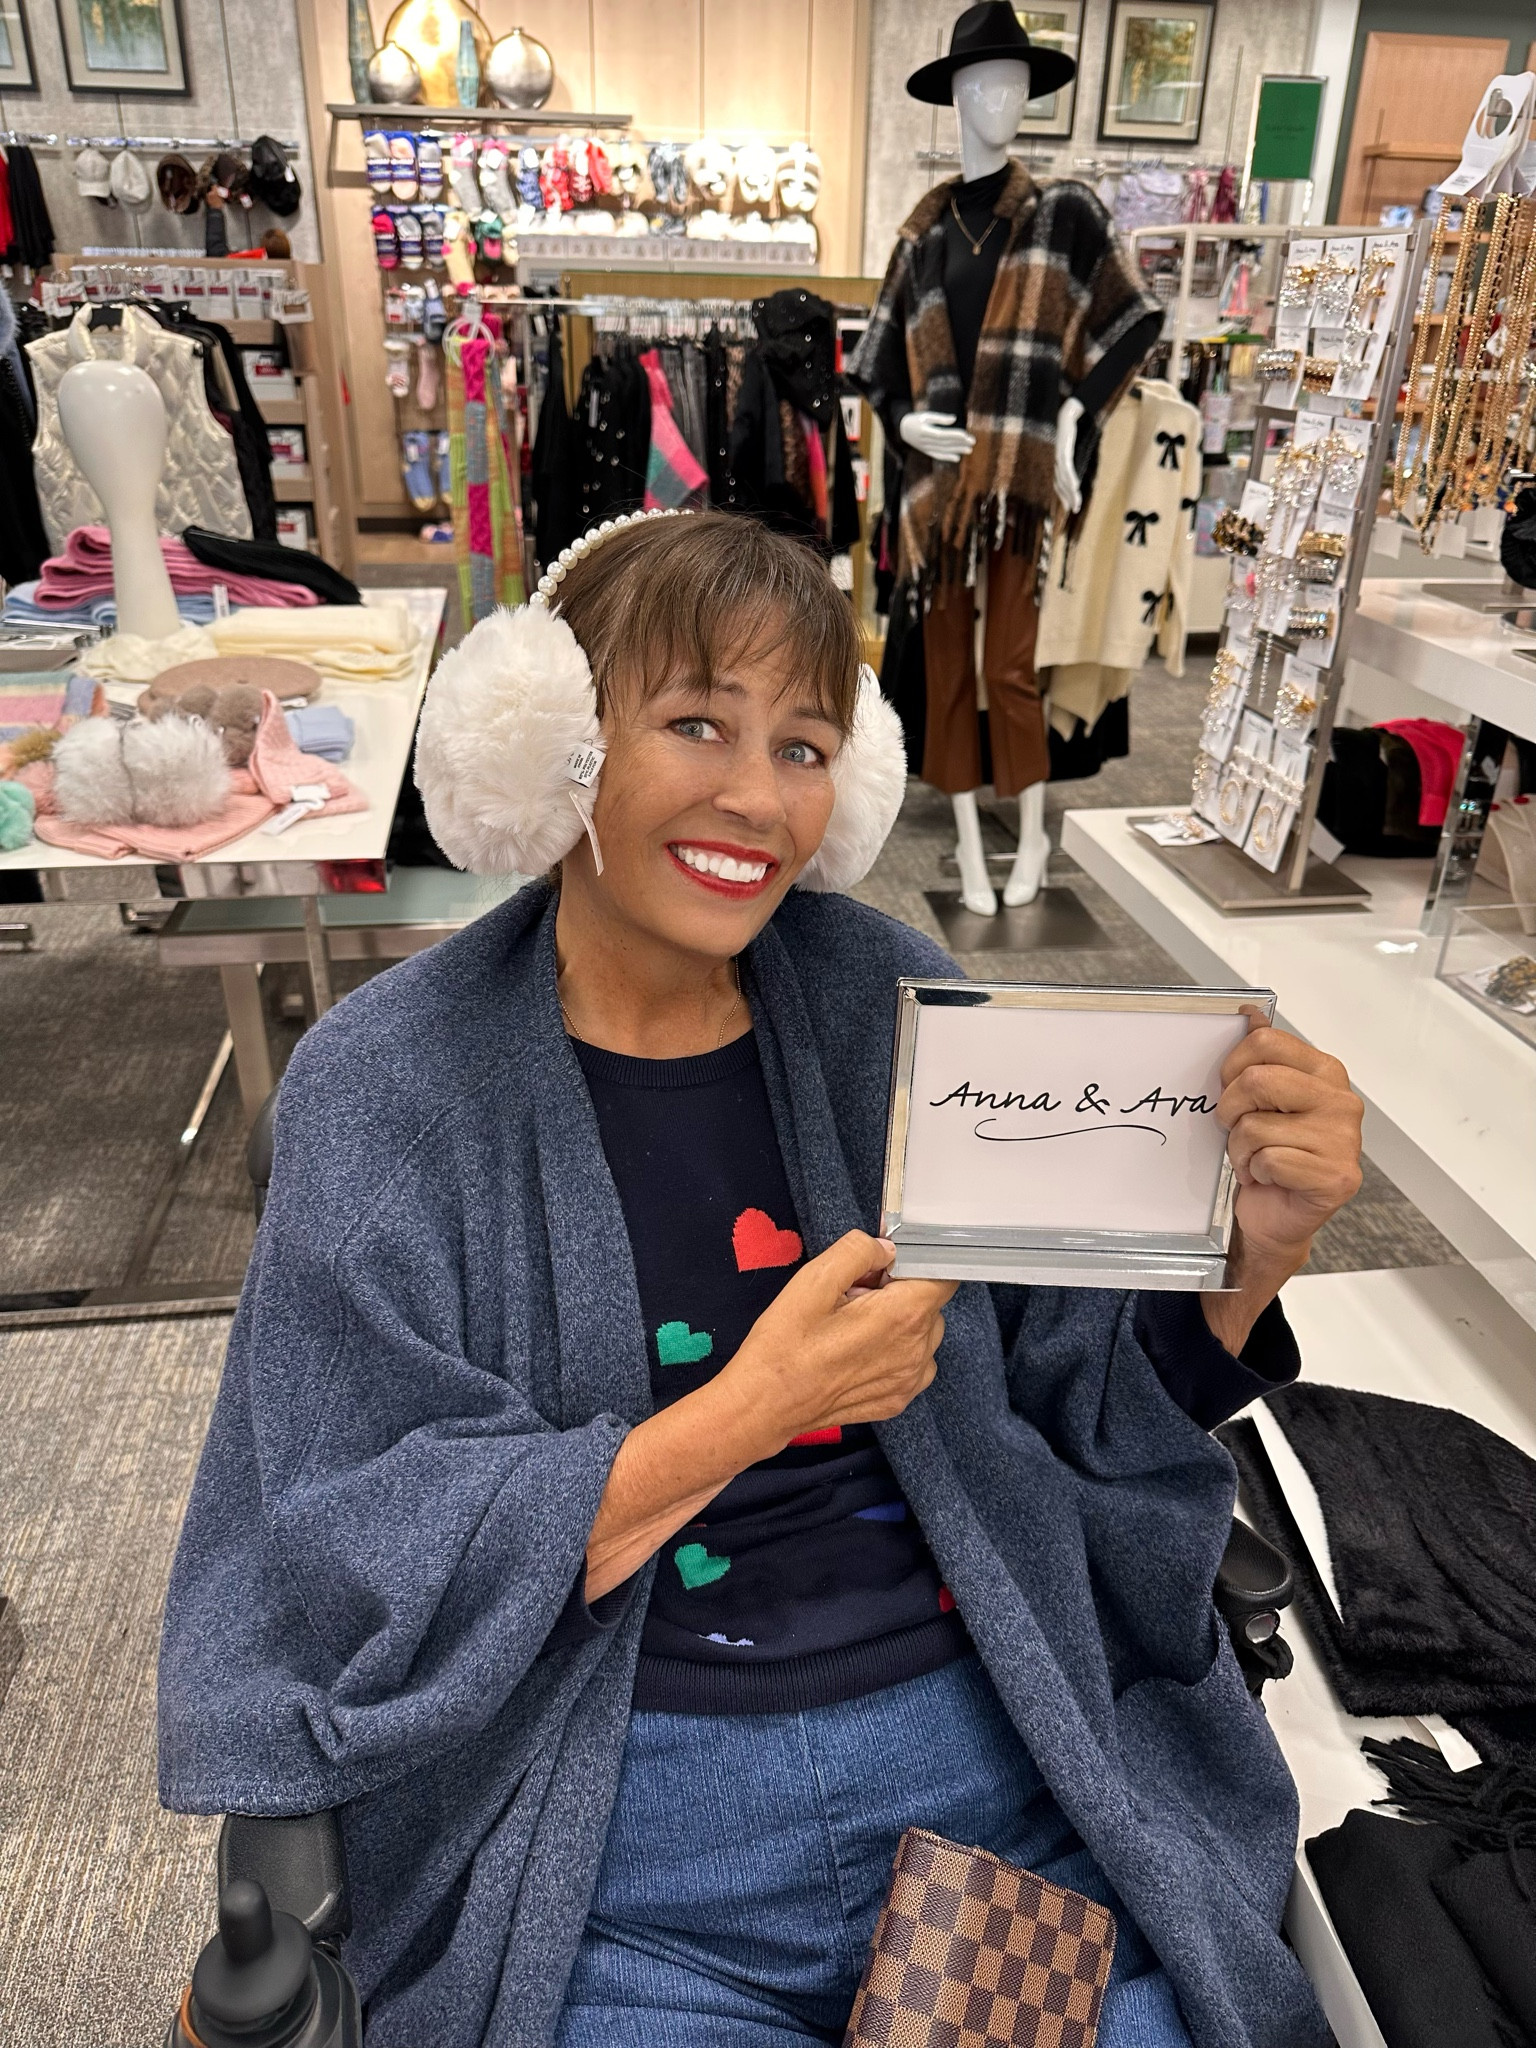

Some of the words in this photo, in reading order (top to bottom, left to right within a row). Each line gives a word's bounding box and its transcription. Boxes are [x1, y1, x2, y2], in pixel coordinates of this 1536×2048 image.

[930, 1081, 1062, 1112] Anna
[1074, 1082, 1111, 1116] &
[1120, 1086, 1218, 1117] Ava
